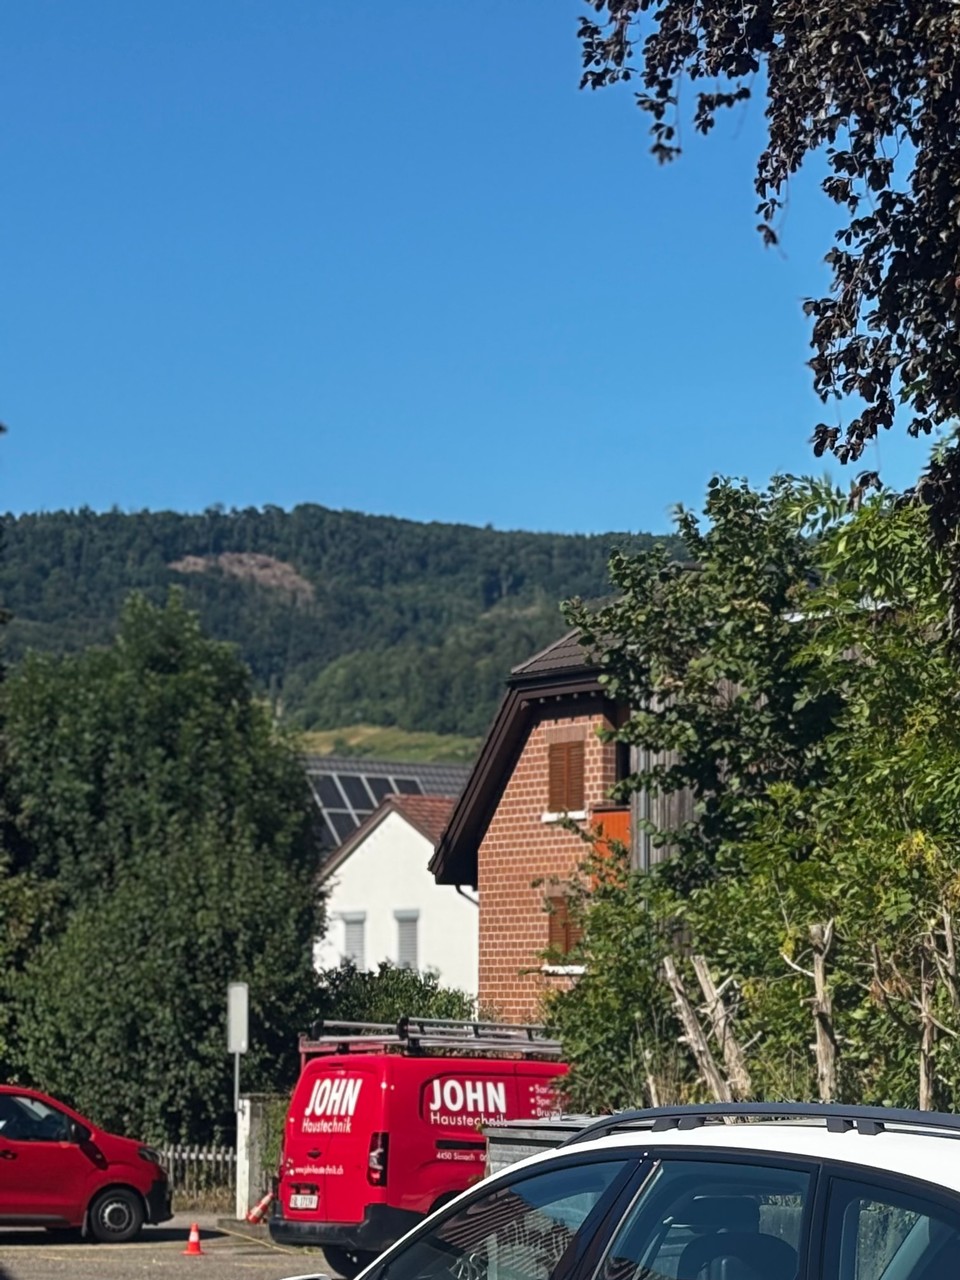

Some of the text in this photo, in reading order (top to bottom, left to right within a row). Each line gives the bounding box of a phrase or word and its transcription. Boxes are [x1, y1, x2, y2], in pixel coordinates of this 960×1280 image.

[304, 1078, 363, 1116] JOHN
[429, 1079, 506, 1113] JOHN
[301, 1116, 352, 1133] Haustechnik
